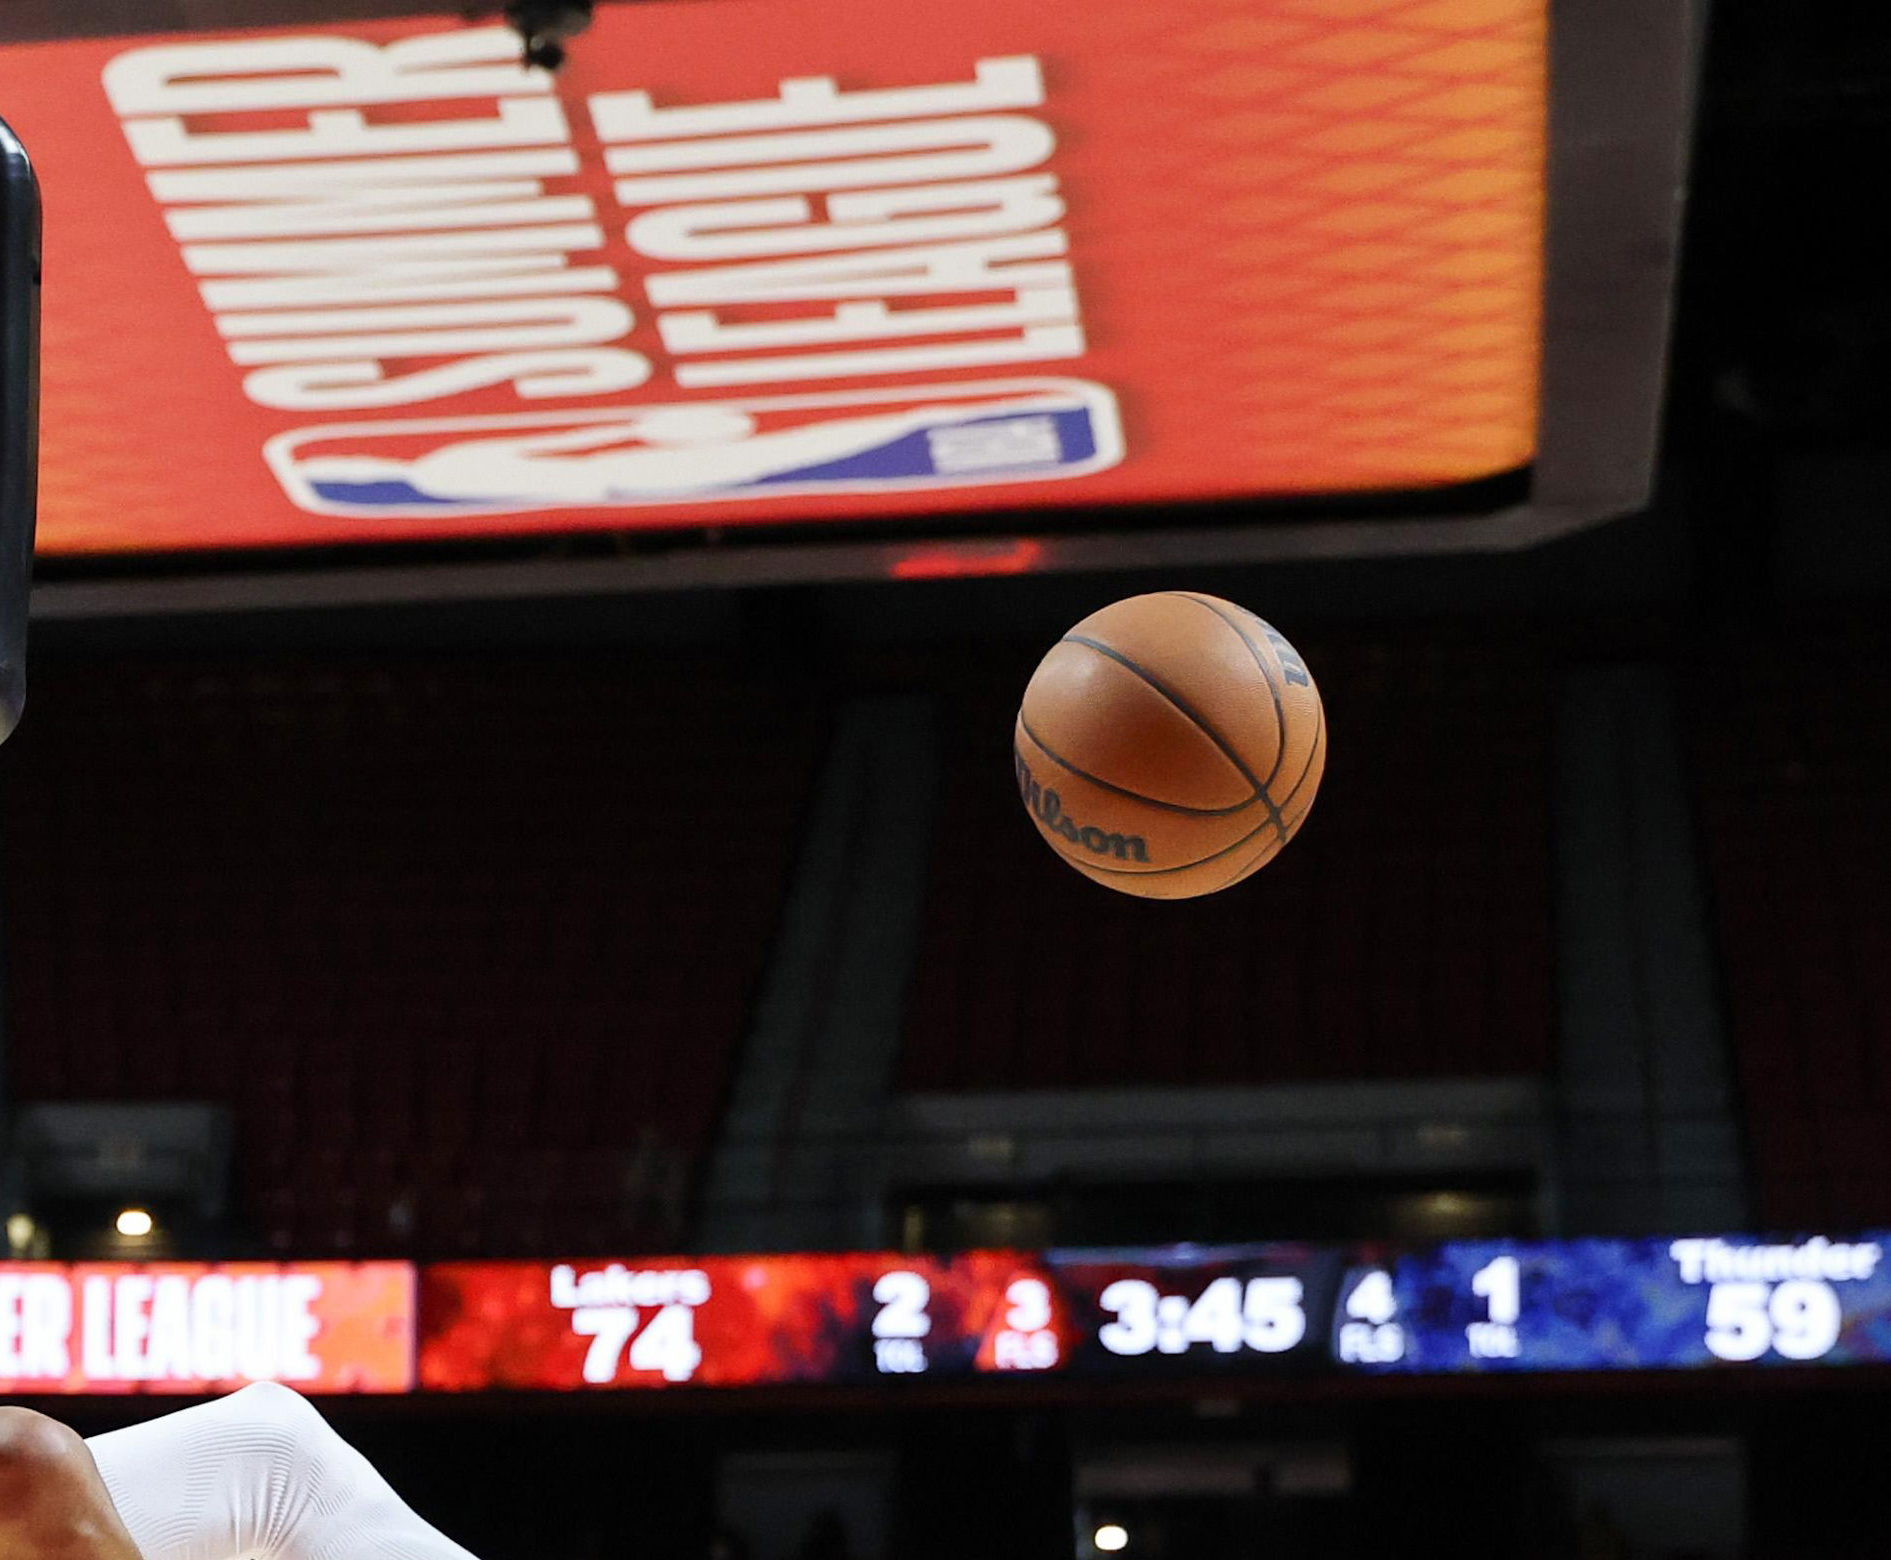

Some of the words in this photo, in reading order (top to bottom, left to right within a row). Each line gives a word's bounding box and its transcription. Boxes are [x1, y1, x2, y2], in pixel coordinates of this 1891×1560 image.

[102, 25, 653, 413] SUMMER
[587, 54, 1086, 390] LEAGUE
[550, 1263, 710, 1310] Lakers
[1346, 1269, 1398, 1325] 4
[1472, 1255, 1521, 1325] 1
[1670, 1235, 1882, 1284] Thunder
[82, 1274, 322, 1381] LEAGUE
[571, 1304, 702, 1383] 74
[872, 1270, 931, 1338] 2
[1005, 1278, 1052, 1332] 3
[1099, 1275, 1306, 1356] 3:45
[1704, 1279, 1842, 1362] 59
